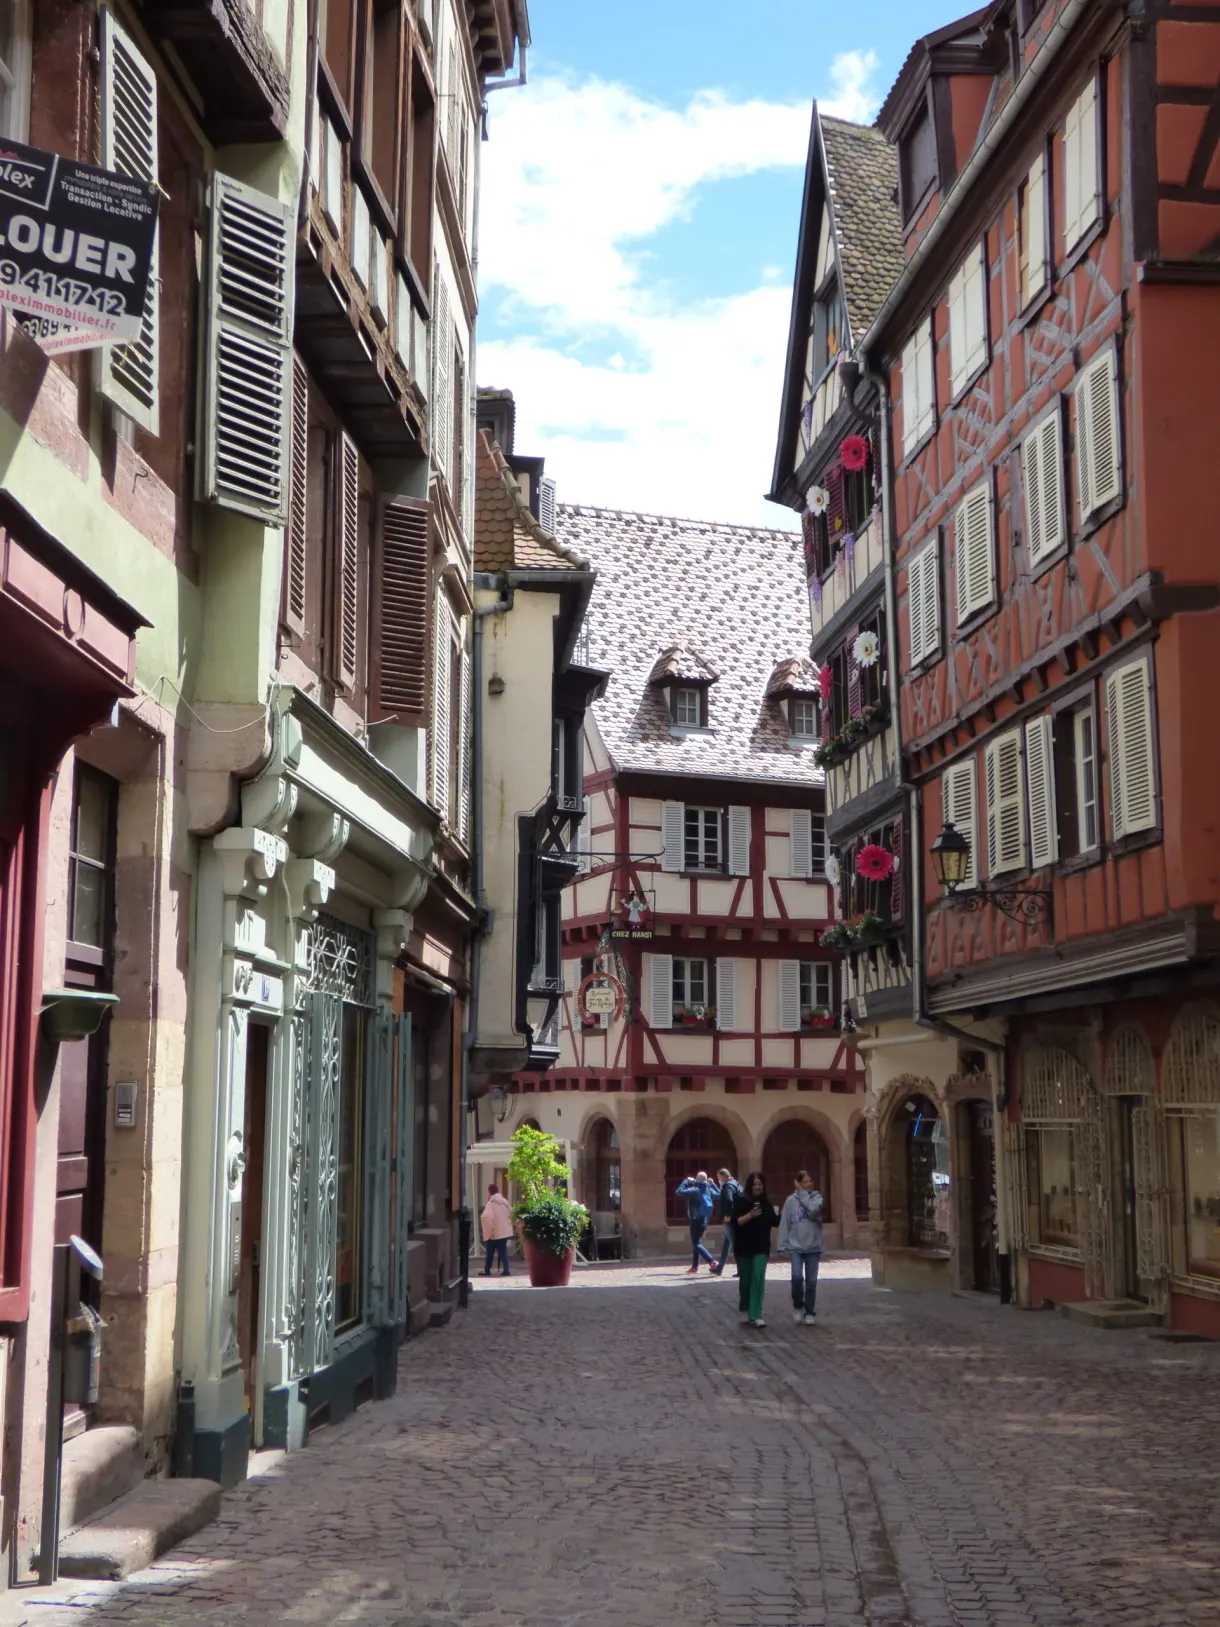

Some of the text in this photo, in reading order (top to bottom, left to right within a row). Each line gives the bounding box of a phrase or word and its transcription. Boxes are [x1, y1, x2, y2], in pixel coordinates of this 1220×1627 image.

[60, 180, 113, 204] Transaction
[121, 198, 153, 215] Syndic
[75, 169, 90, 180] Une
[91, 174, 109, 186] triple
[110, 180, 142, 195] expertise
[67, 192, 143, 221] Gestion Locative
[0, 214, 136, 284] OUER
